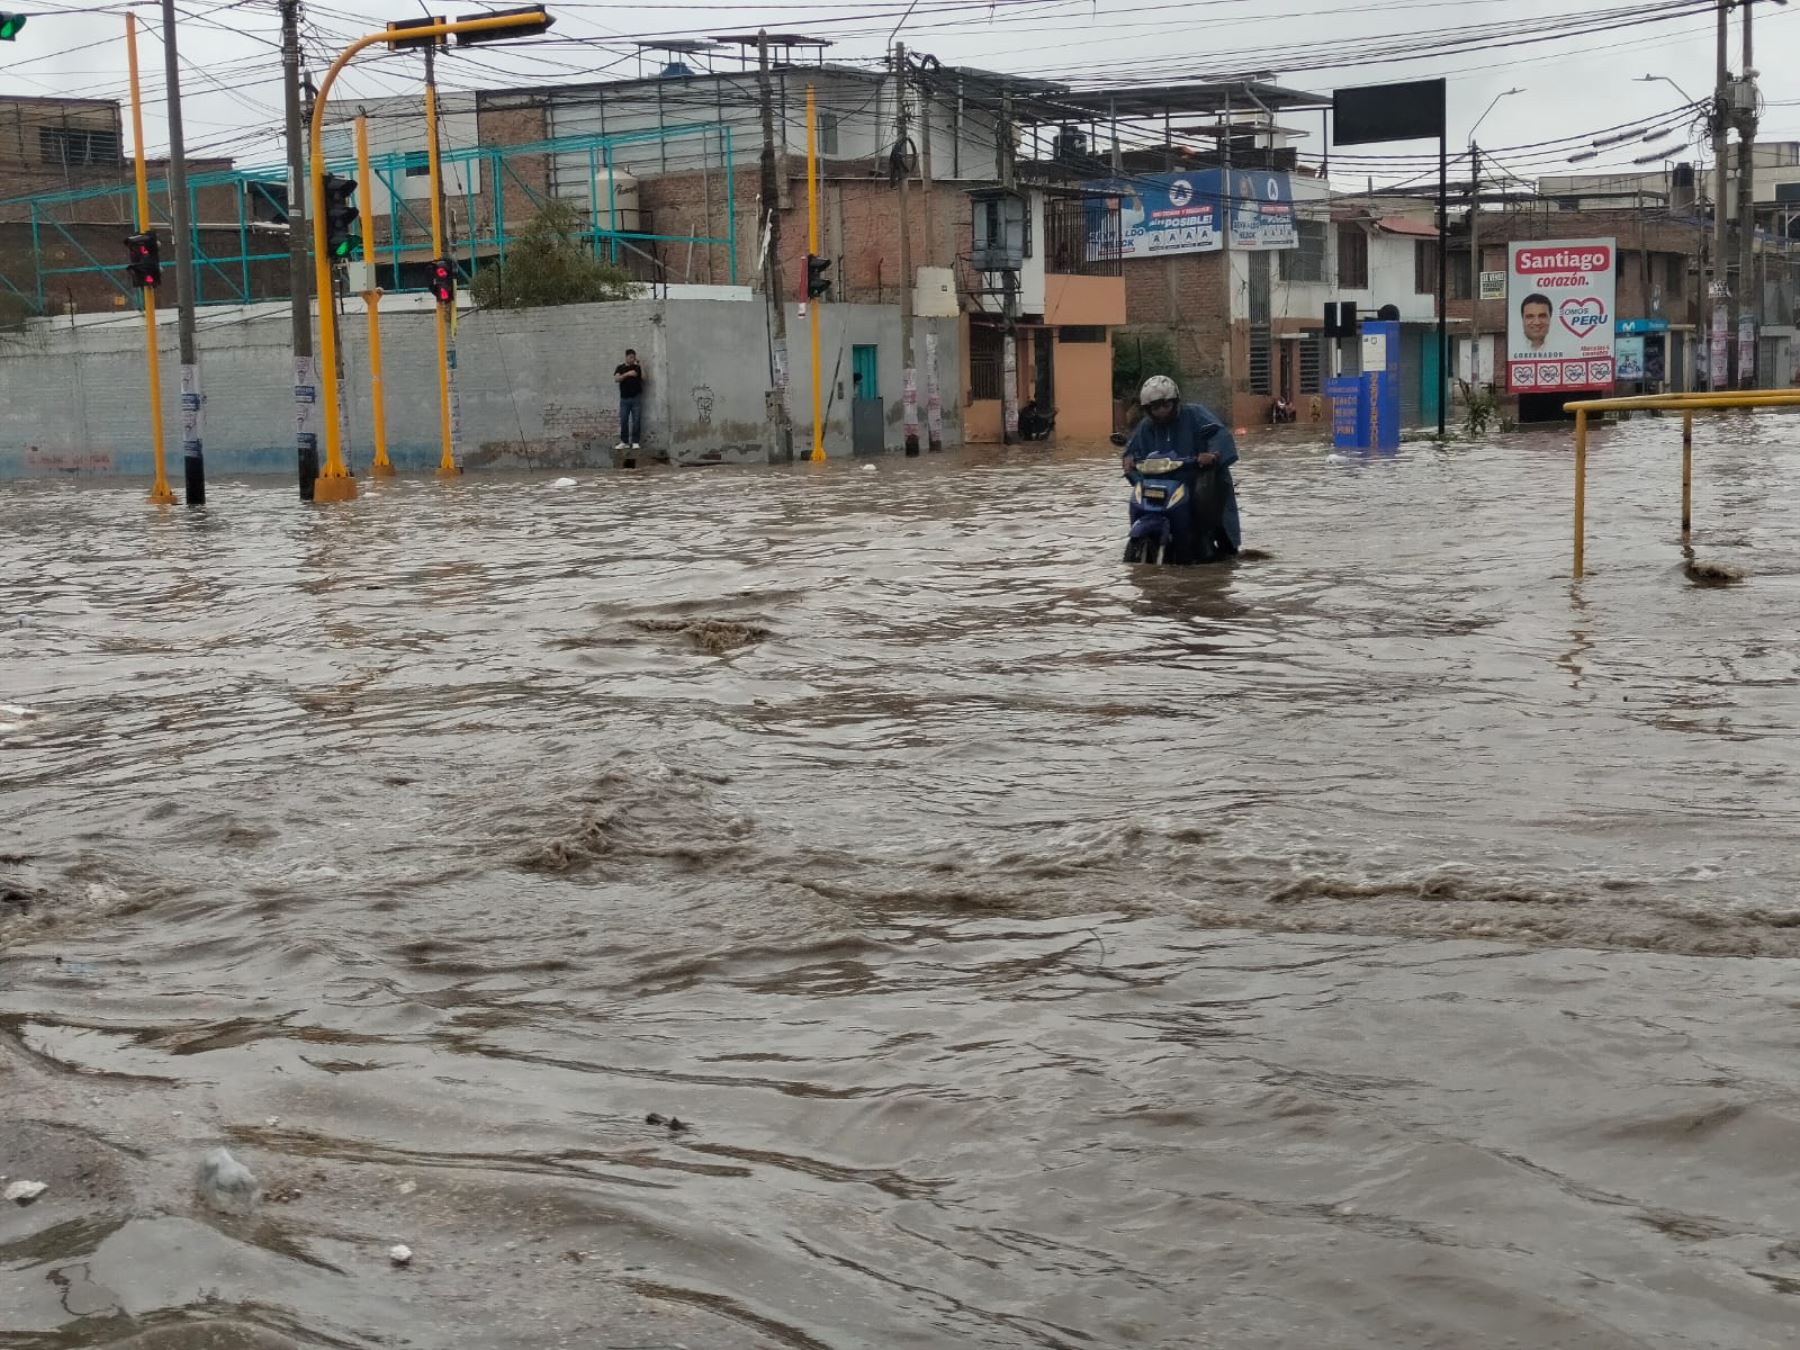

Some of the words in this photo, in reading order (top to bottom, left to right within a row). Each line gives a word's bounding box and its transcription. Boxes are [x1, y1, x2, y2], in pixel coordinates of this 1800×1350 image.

[1521, 251, 1605, 270] Santiago
[1537, 272, 1589, 288] corazón.
[1571, 314, 1608, 326] PERU
[1513, 351, 1564, 359] GOBERNADOR
